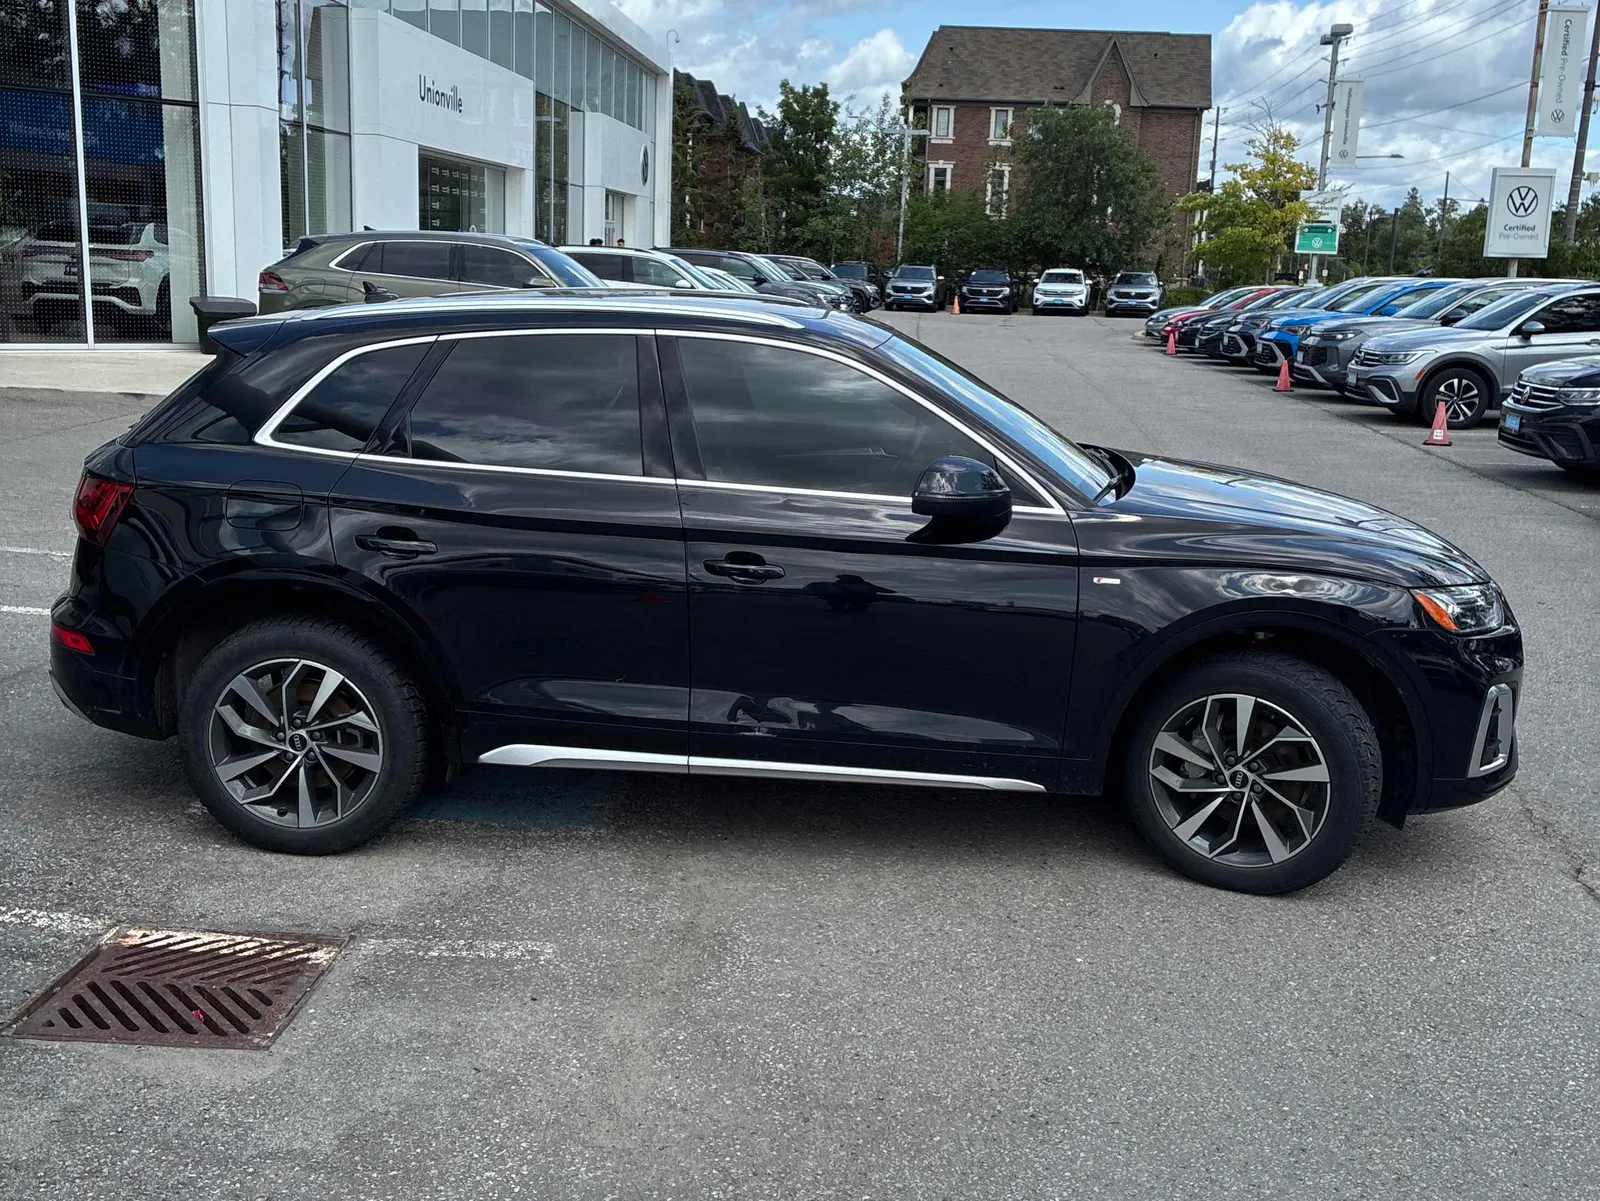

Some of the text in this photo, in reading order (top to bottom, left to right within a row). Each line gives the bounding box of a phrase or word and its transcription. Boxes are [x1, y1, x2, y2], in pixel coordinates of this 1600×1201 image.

[1556, 19, 1572, 104] Certified Pre-Owned
[419, 74, 463, 114] Unionville
[1498, 232, 1539, 240] Pre-Owned
[1503, 223, 1536, 232] Certified
